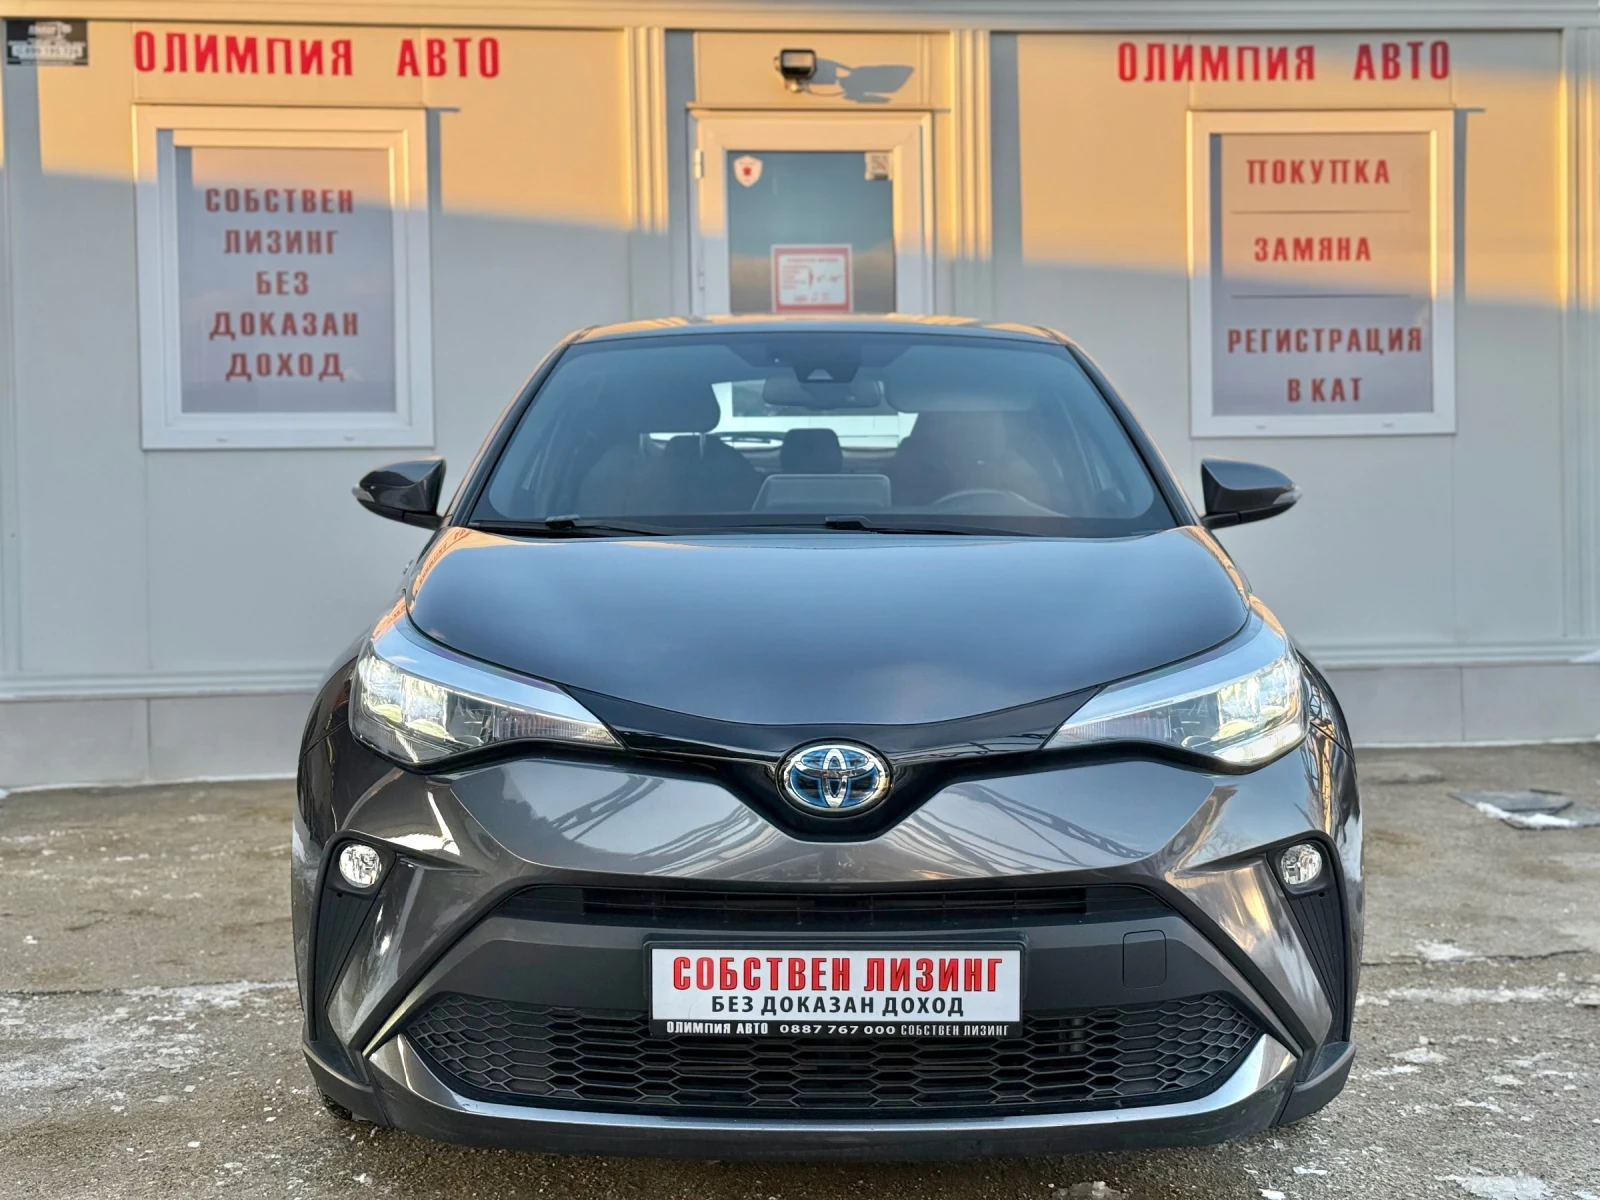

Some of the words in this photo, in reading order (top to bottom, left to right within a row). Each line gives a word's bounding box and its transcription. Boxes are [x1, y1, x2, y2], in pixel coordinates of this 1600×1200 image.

[134, 31, 353, 76] ОЛИМПИЯ
[397, 37, 500, 78] АВТО
[1118, 41, 1315, 82] ОЛИМПИЯ
[1353, 40, 1450, 81] АВТО
[1246, 159, 1390, 184] ПОКУПКА
[206, 188, 354, 214] СОБСТВЕН
[224, 229, 339, 255] ЛИЗИНГ
[1254, 236, 1371, 262] ЗАМЯНА
[256, 271, 309, 296] БЕЗ
[209, 312, 359, 341] ДОКАЗАН
[1227, 327, 1422, 355] РЕГИСТРАЦИЯ
[225, 352, 345, 381] ДОХОД
[1288, 378, 1300, 402] В
[1311, 377, 1362, 402] КАТ
[673, 956, 850, 991] СОБСТВЕН
[864, 958, 1002, 992] ЛИЗИНГ
[712, 996, 754, 1013] БЕЗ
[761, 996, 874, 1016] ДОКАЗАН
[882, 997, 964, 1017] ДОХОД
[666, 1021, 731, 1034] ОЛИМПИЯ
[736, 1023, 768, 1035] АВТО
[779, 1024, 822, 1034] 0887
[827, 1025, 859, 1035] 767
[863, 1025, 896, 1035] 000
[901, 1025, 959, 1036] СОБСТВЕН
[963, 1025, 1009, 1036] ЛИЗИНГ
